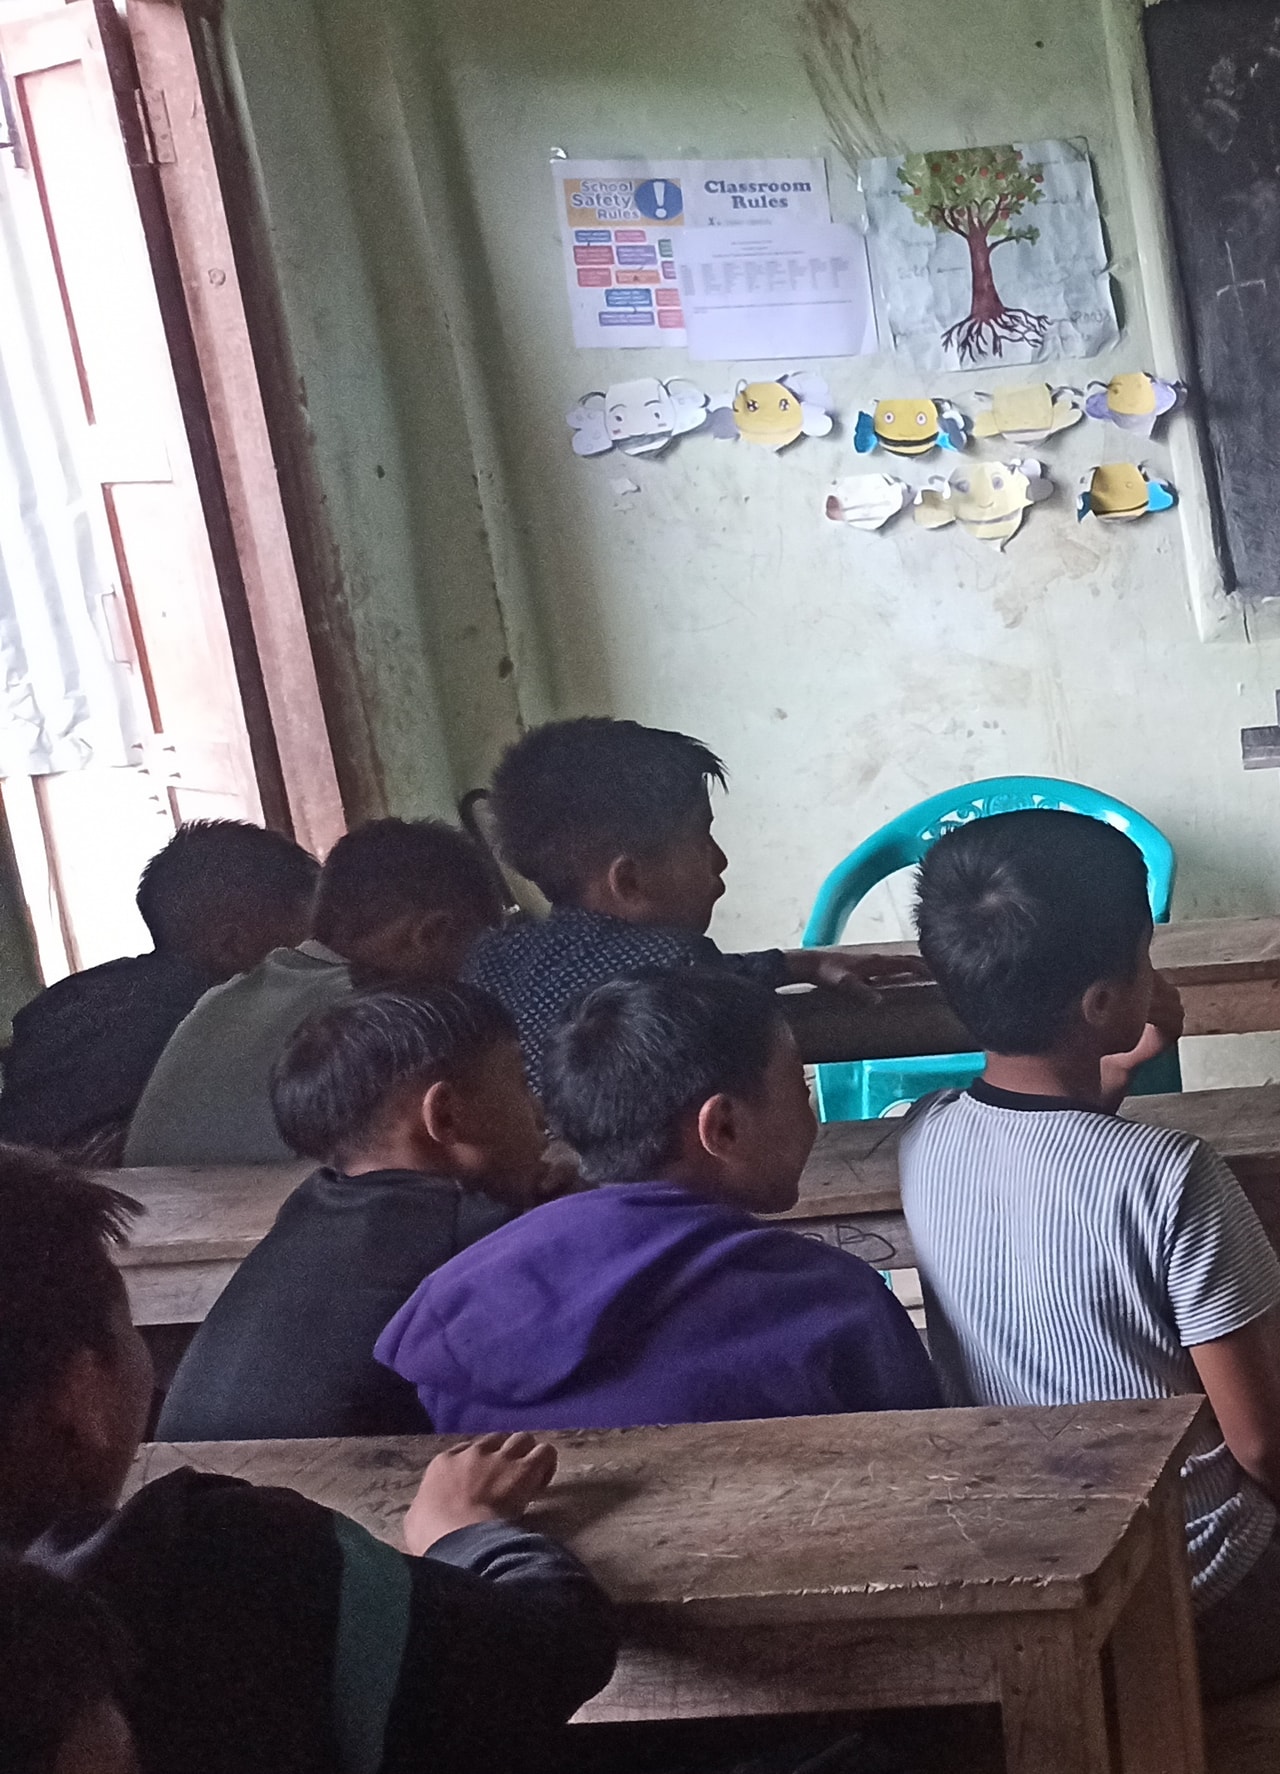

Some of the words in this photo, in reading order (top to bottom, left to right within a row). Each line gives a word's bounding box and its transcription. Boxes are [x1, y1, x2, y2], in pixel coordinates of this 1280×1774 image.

[580, 181, 633, 192] School
[704, 180, 812, 194] Classroom
[572, 193, 632, 209] Safety
[731, 195, 789, 209] Rules
[597, 208, 639, 220] Rules
